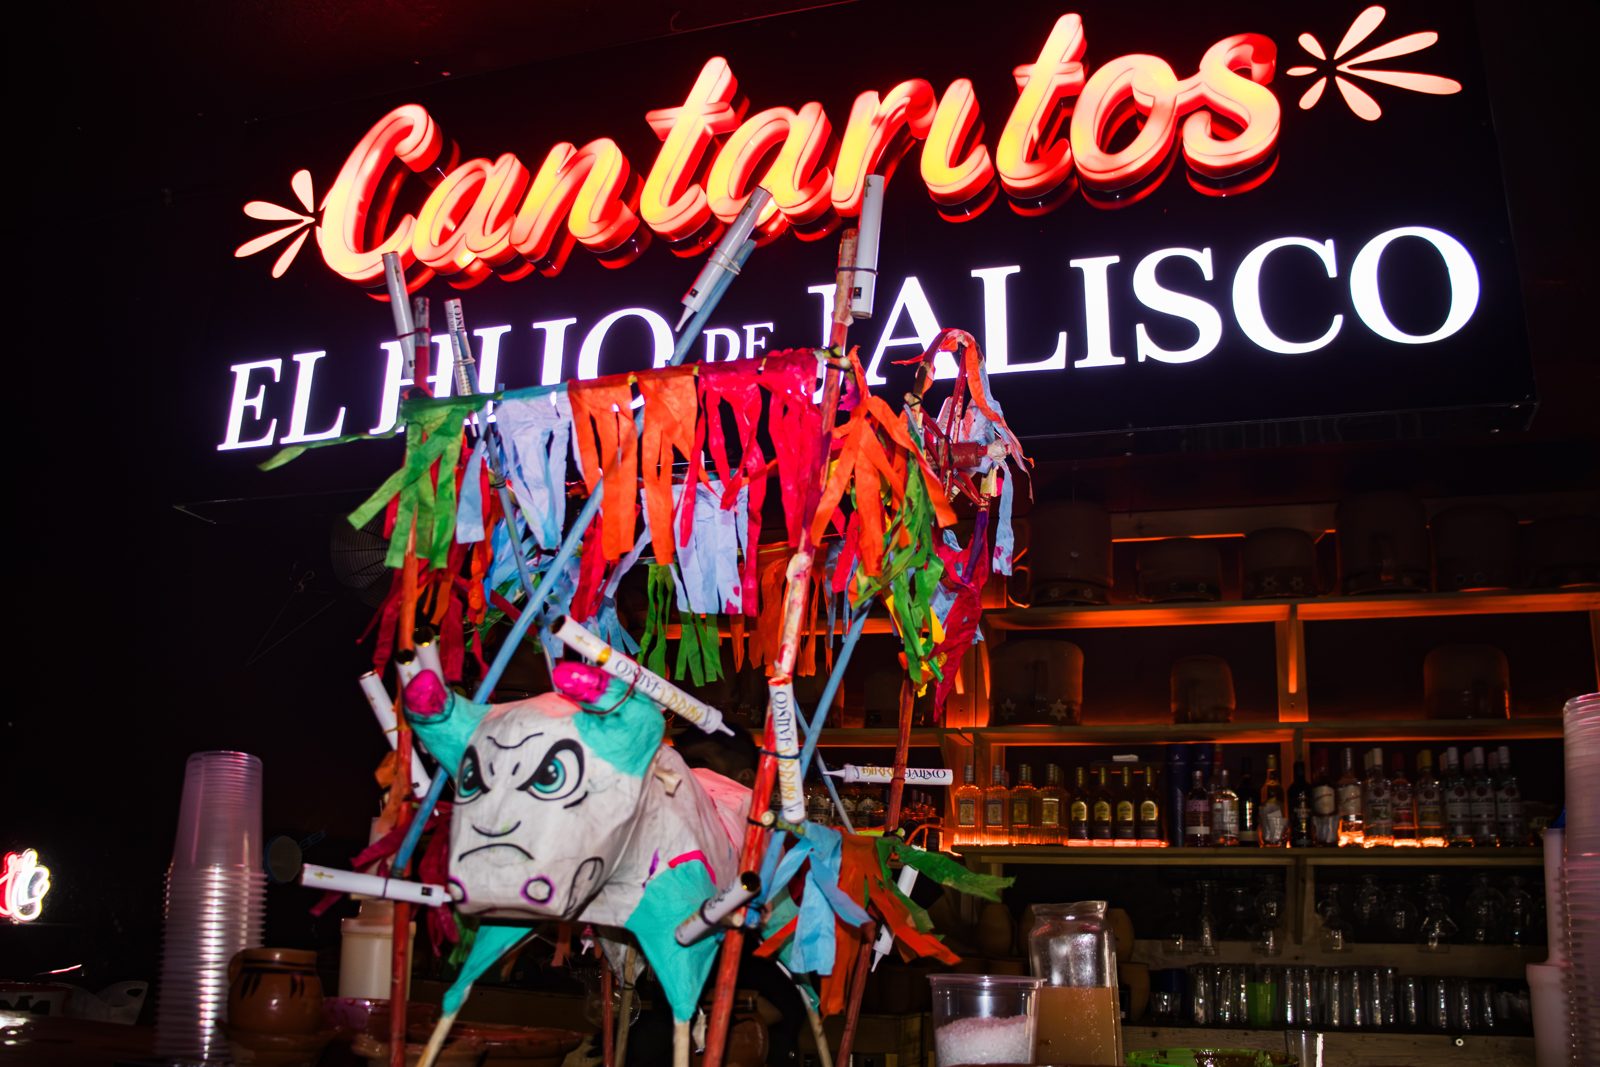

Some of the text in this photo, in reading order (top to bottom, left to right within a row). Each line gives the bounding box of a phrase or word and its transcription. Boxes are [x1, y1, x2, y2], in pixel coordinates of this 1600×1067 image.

[316, 11, 1281, 283] Cantaritos
[216, 348, 348, 452] EL
[702, 321, 775, 363] DE
